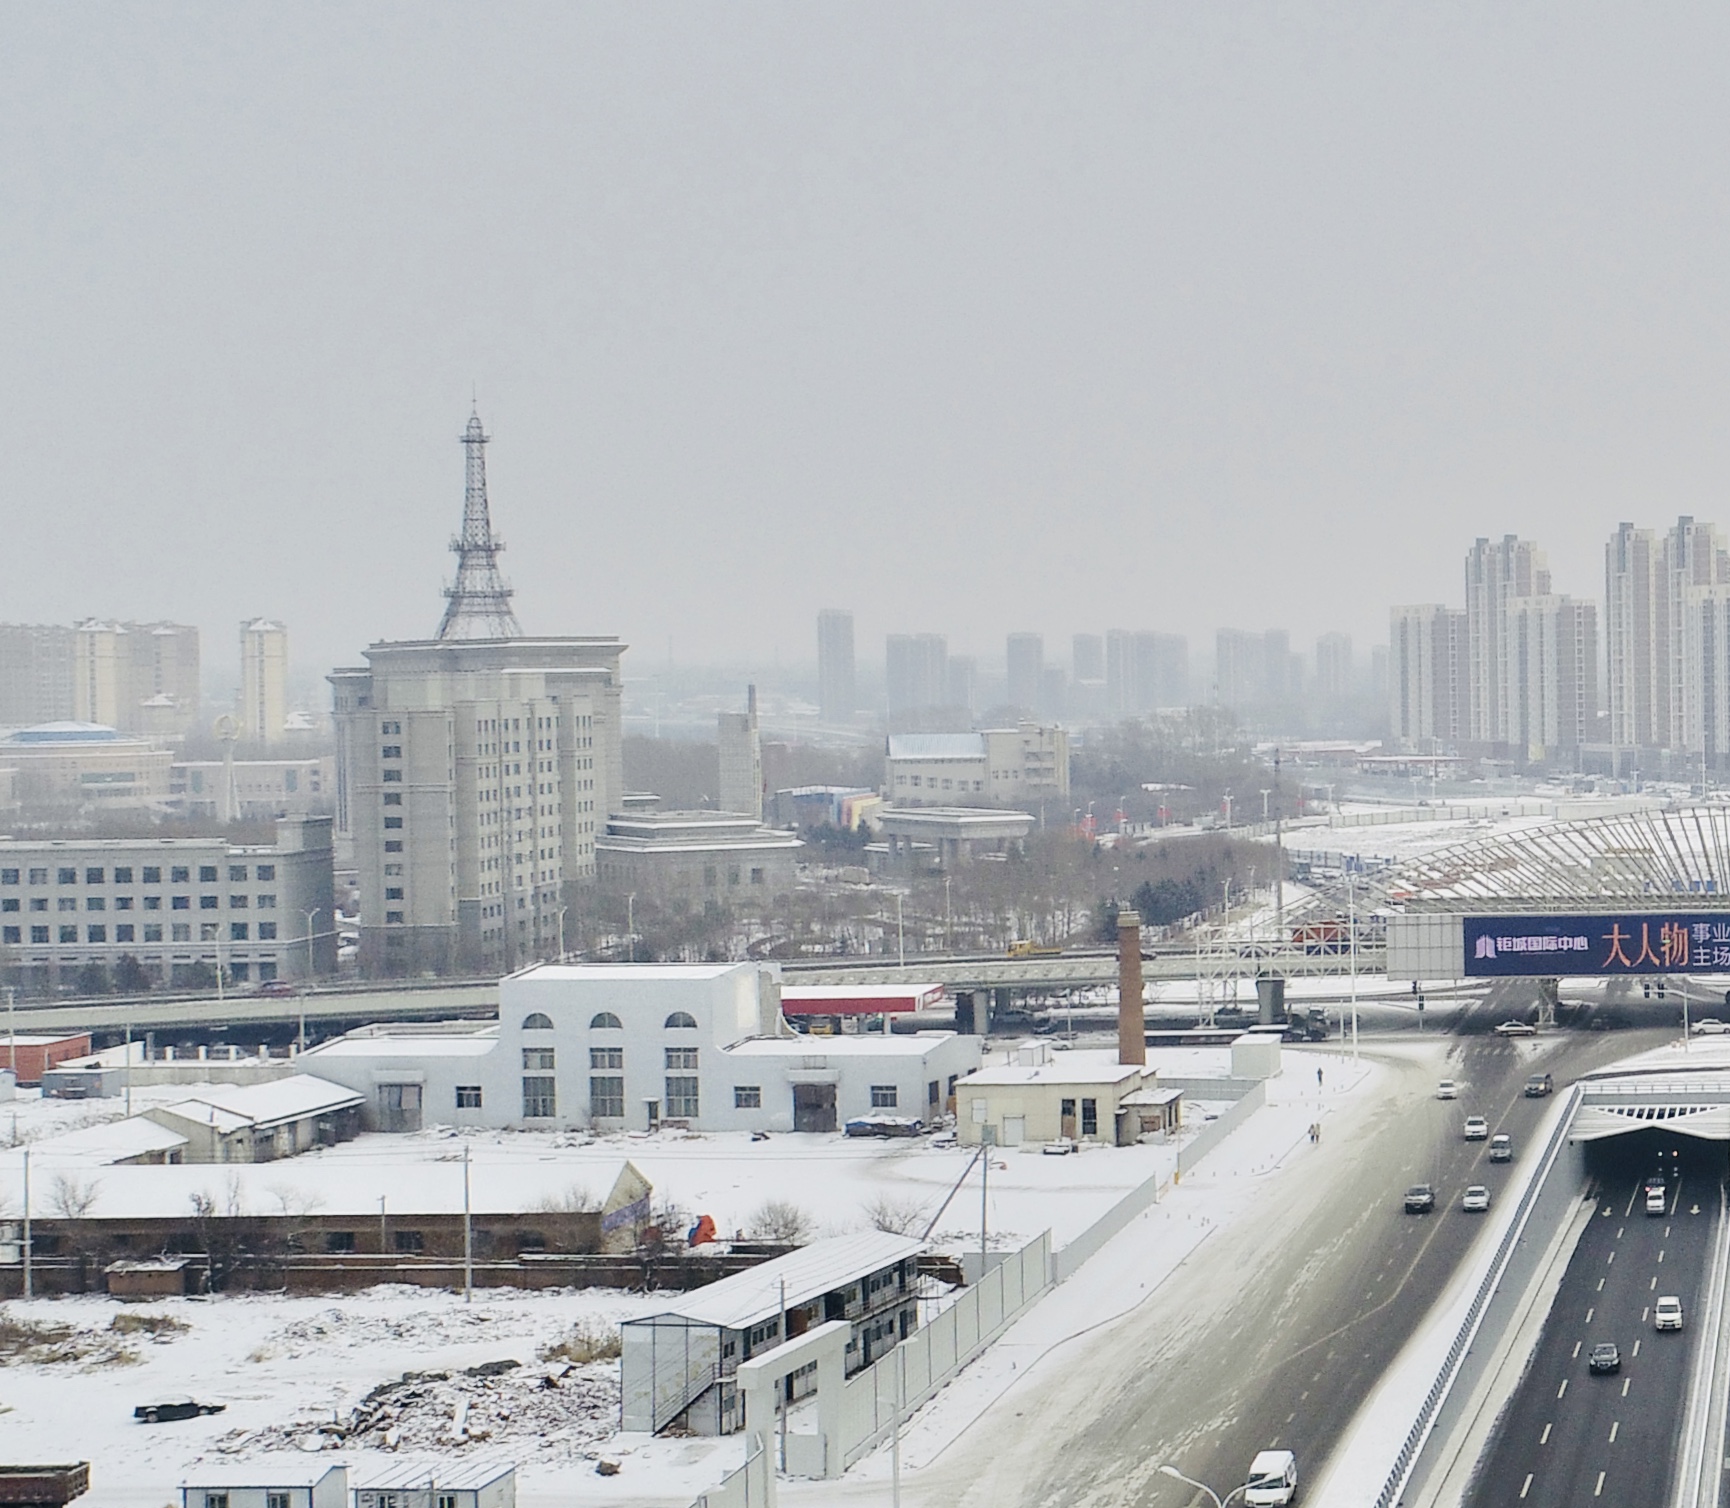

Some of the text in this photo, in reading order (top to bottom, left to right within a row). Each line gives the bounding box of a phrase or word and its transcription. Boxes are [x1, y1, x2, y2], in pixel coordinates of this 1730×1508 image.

[1601, 922, 1689, 968] 大人物
[1692, 922, 1730, 943] 事业
